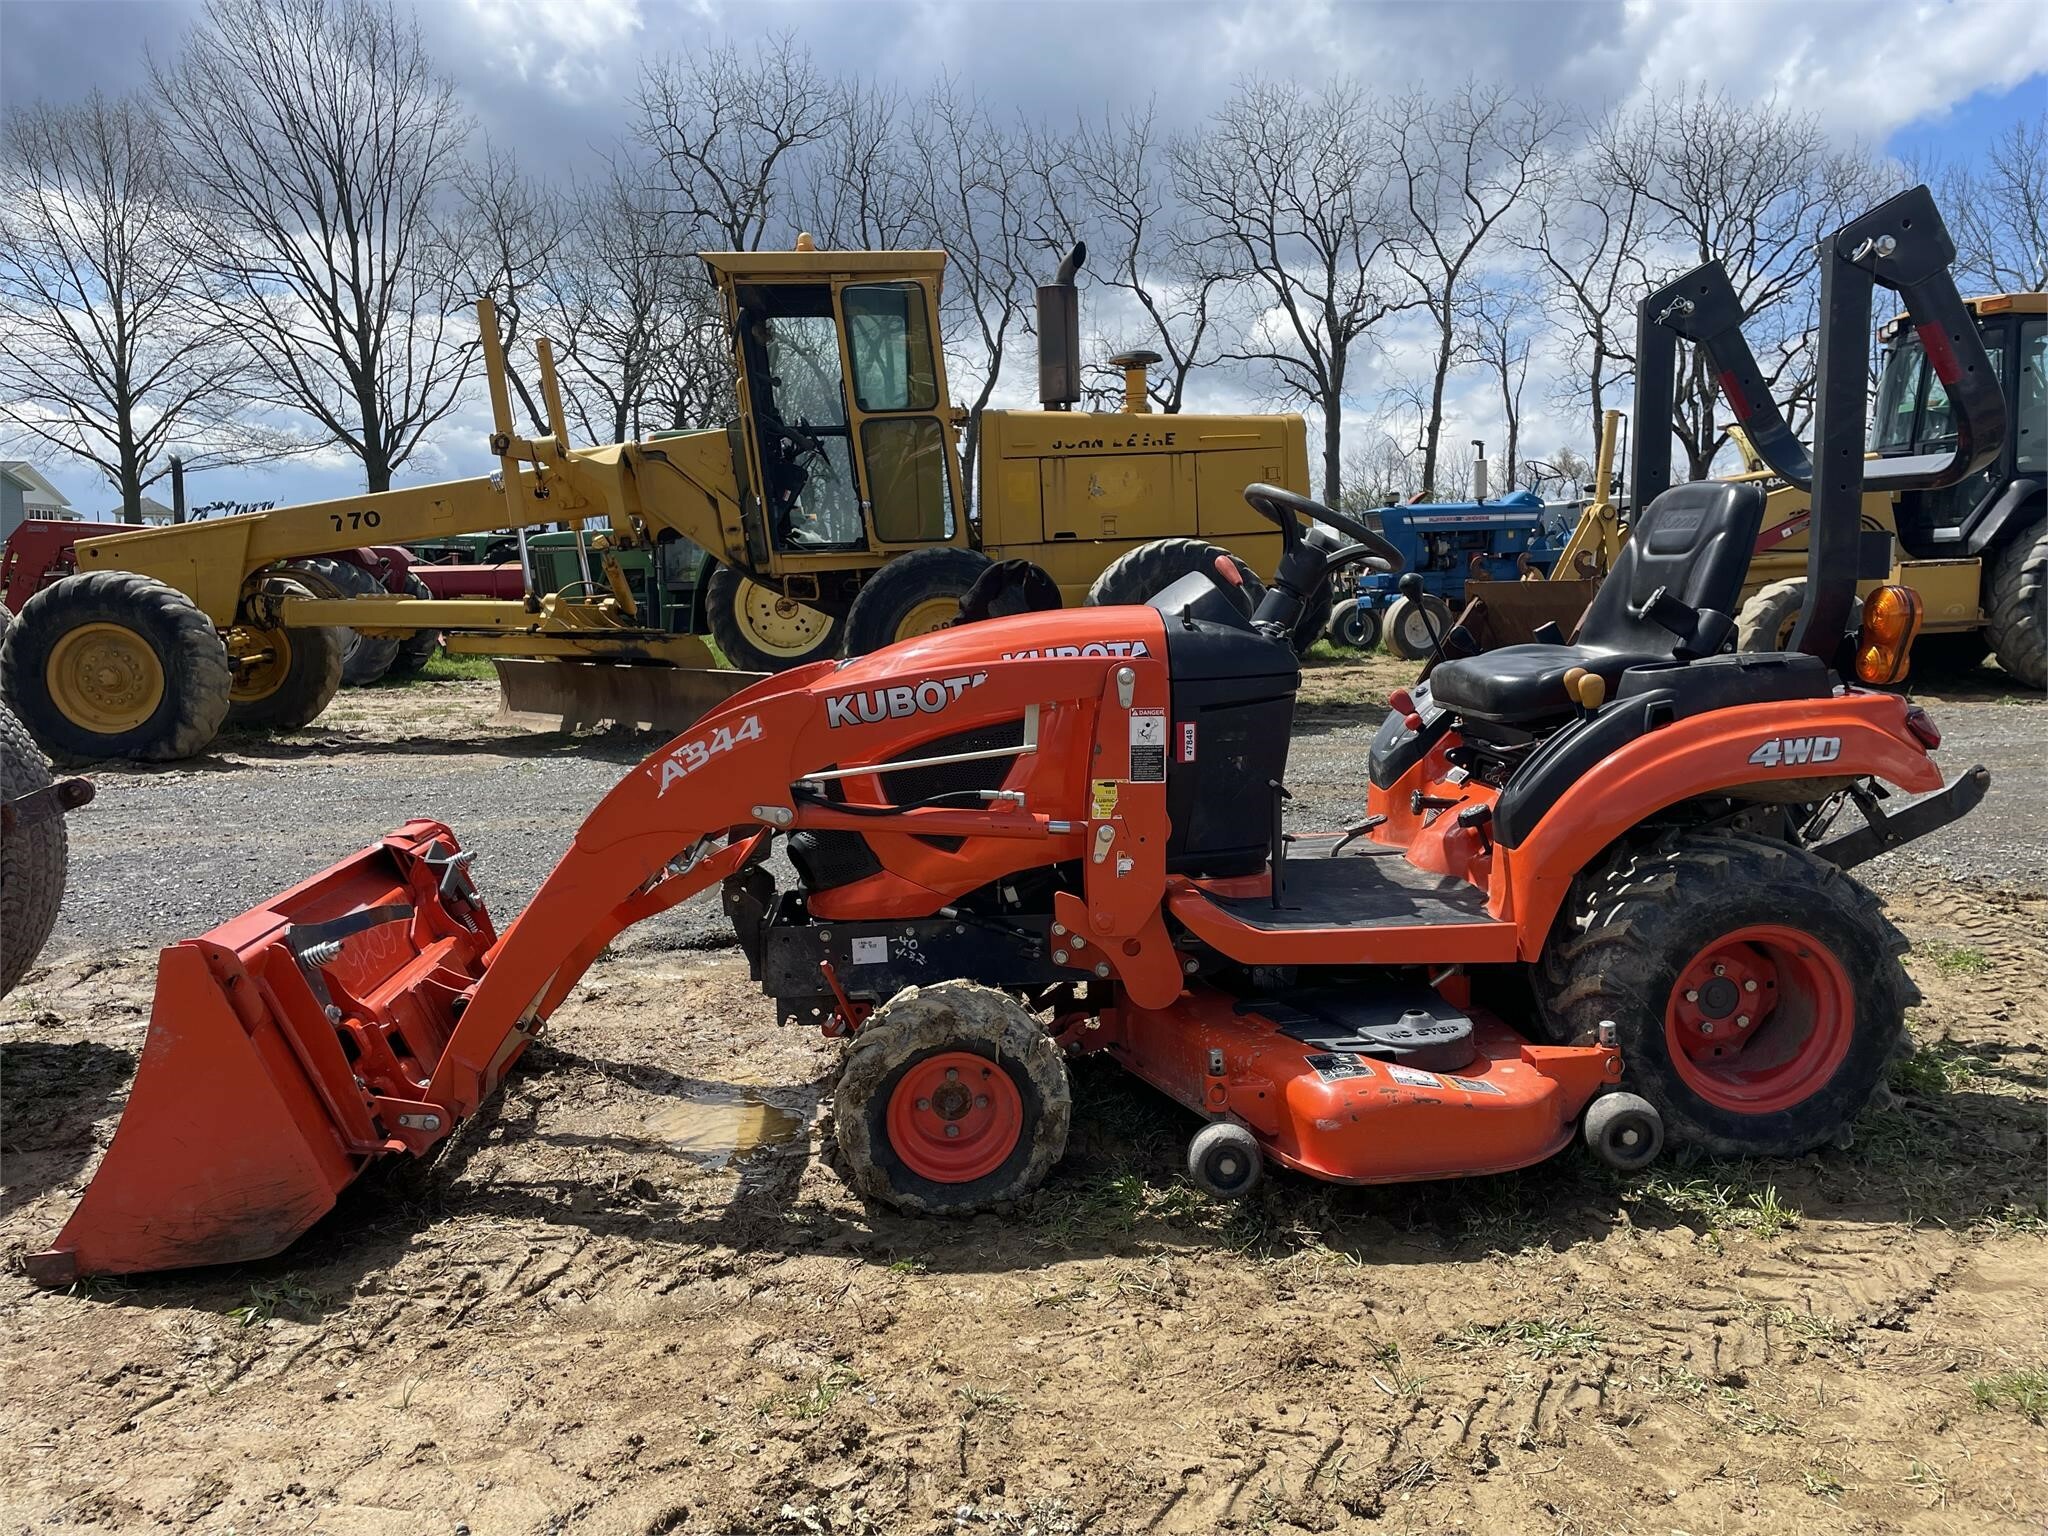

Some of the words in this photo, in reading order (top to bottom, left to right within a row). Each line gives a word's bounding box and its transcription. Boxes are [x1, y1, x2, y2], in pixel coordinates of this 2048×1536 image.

[330, 510, 381, 532] 770
[1000, 639, 1152, 662] OTA
[1185, 729, 1194, 756] 47848
[1747, 736, 1842, 768] 4WD
[1386, 1030, 1413, 1039] NO
[1415, 1025, 1459, 1036] STEP
